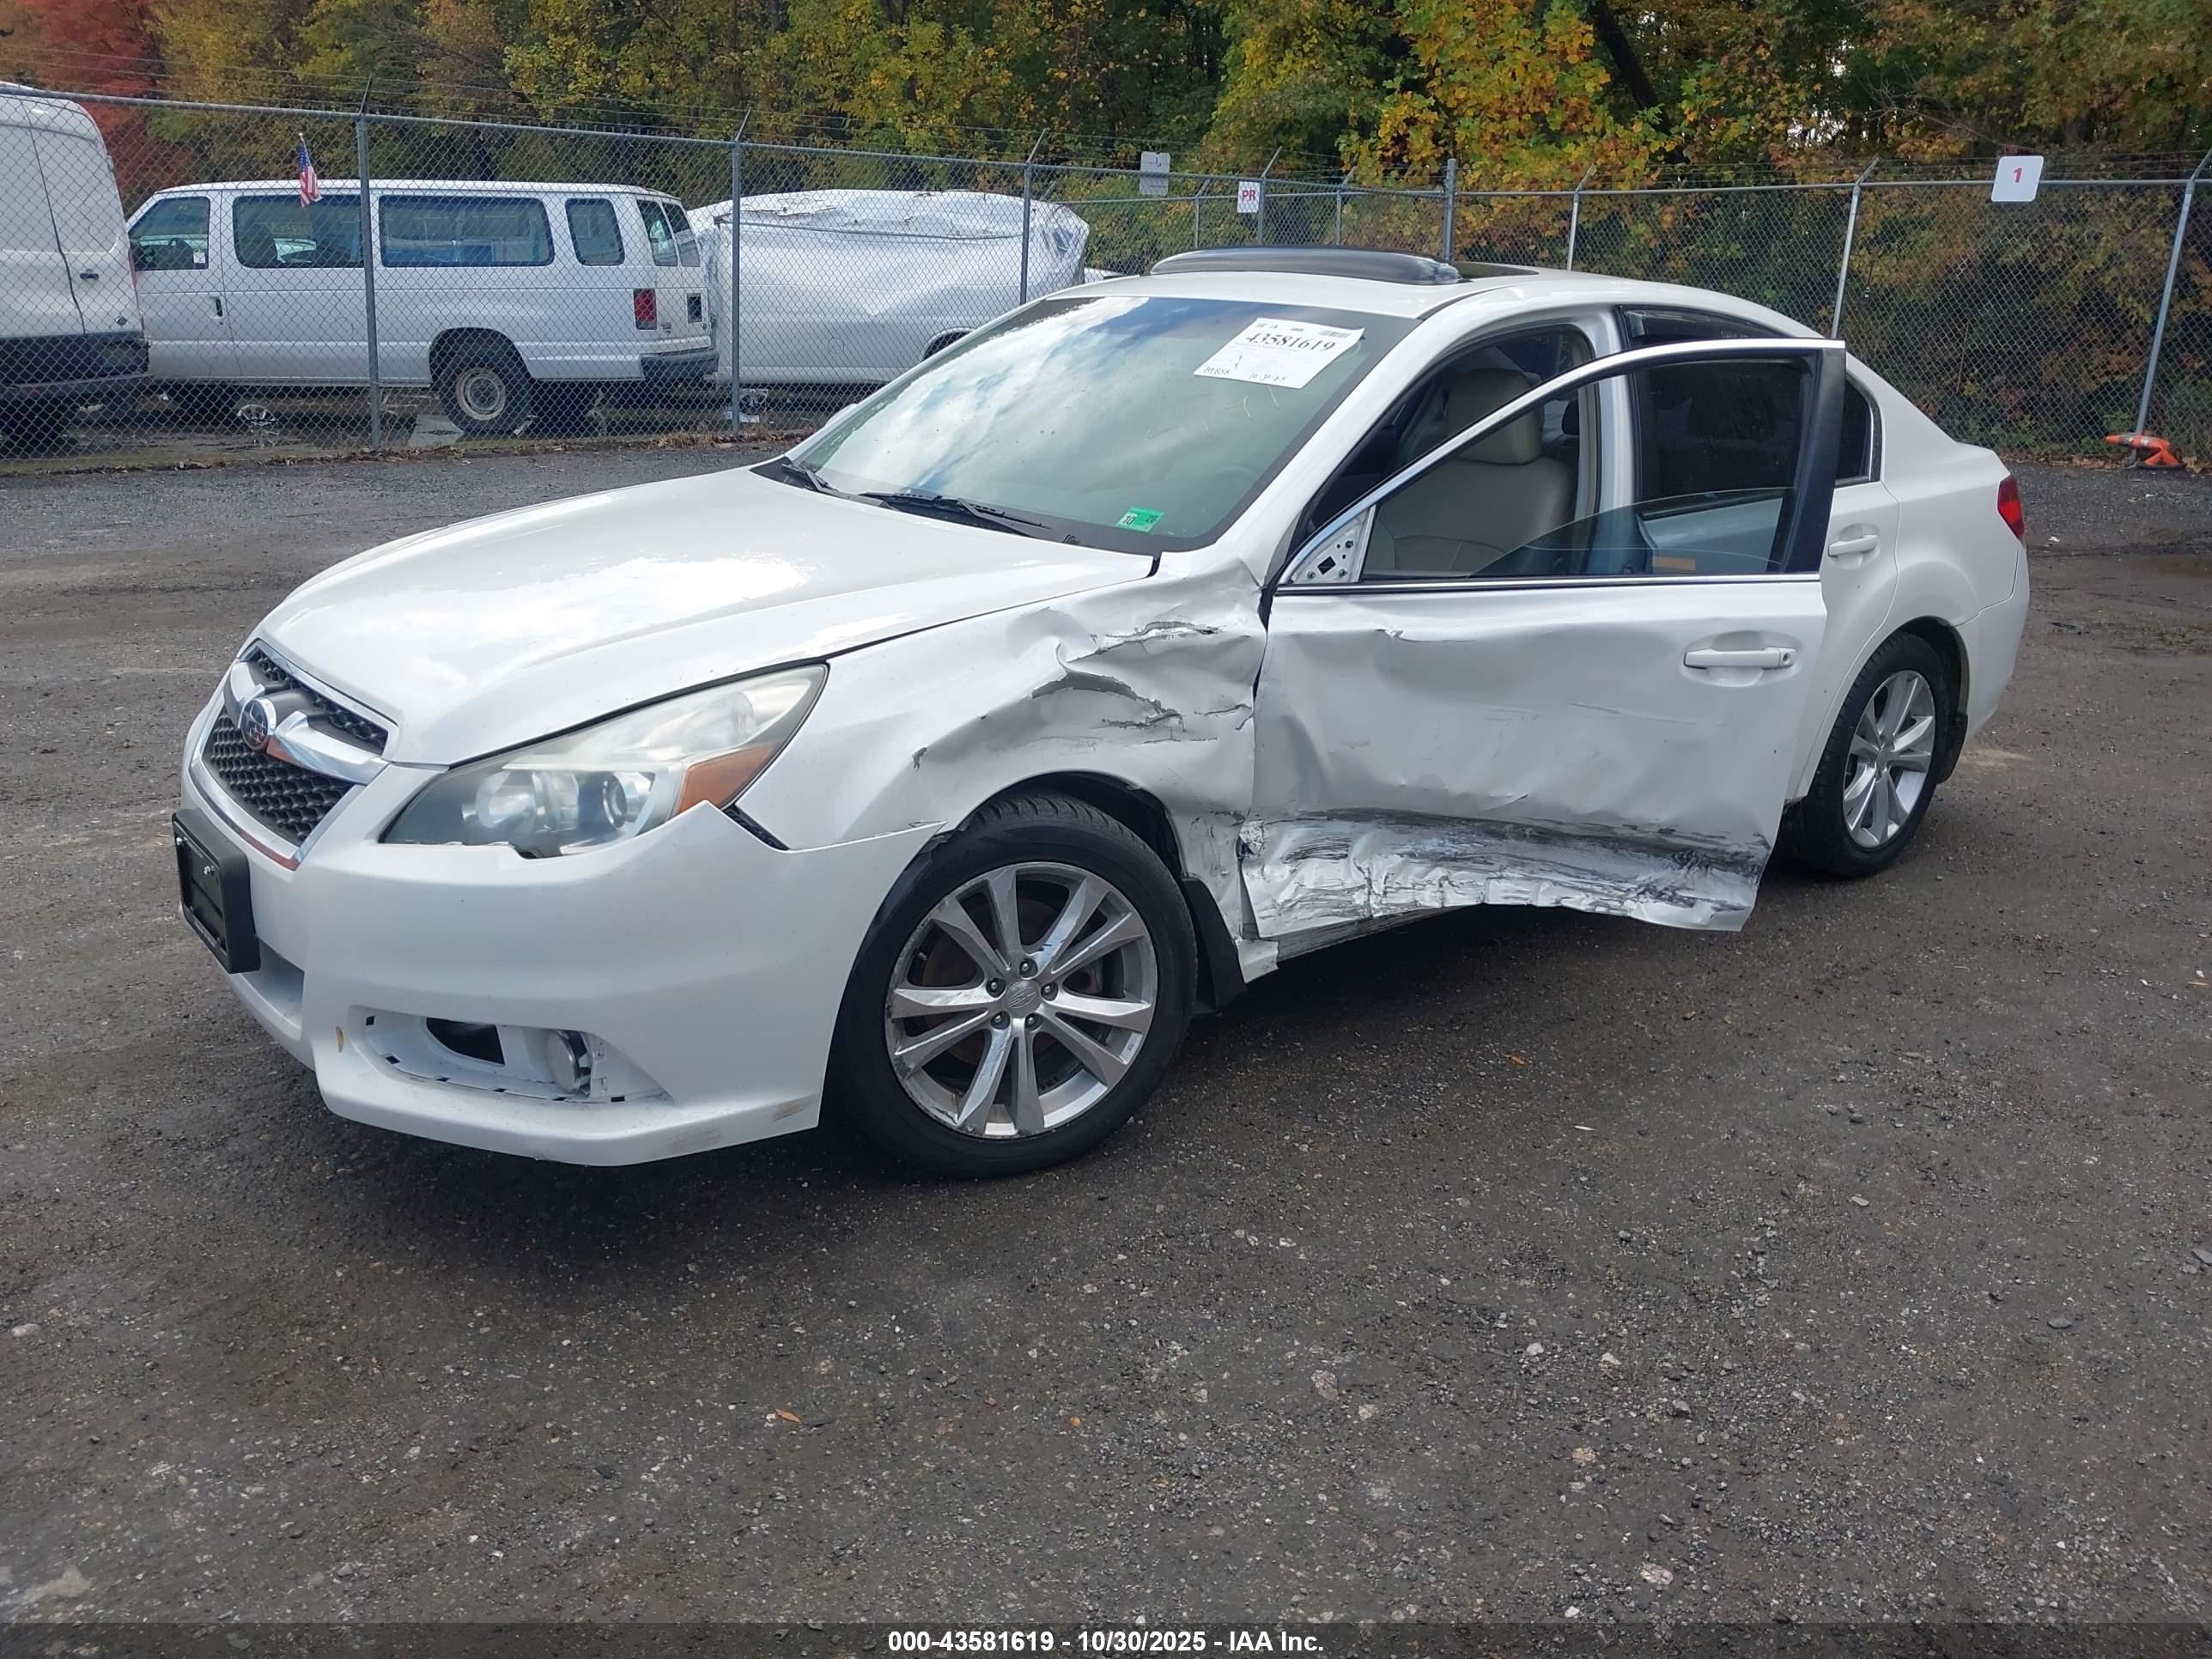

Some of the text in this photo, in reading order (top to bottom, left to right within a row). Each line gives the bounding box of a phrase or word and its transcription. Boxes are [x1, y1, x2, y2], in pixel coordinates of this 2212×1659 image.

[2014, 167, 2022, 183] 1
[1242, 189, 1256, 201] PR
[1246, 331, 1336, 351] 43581619
